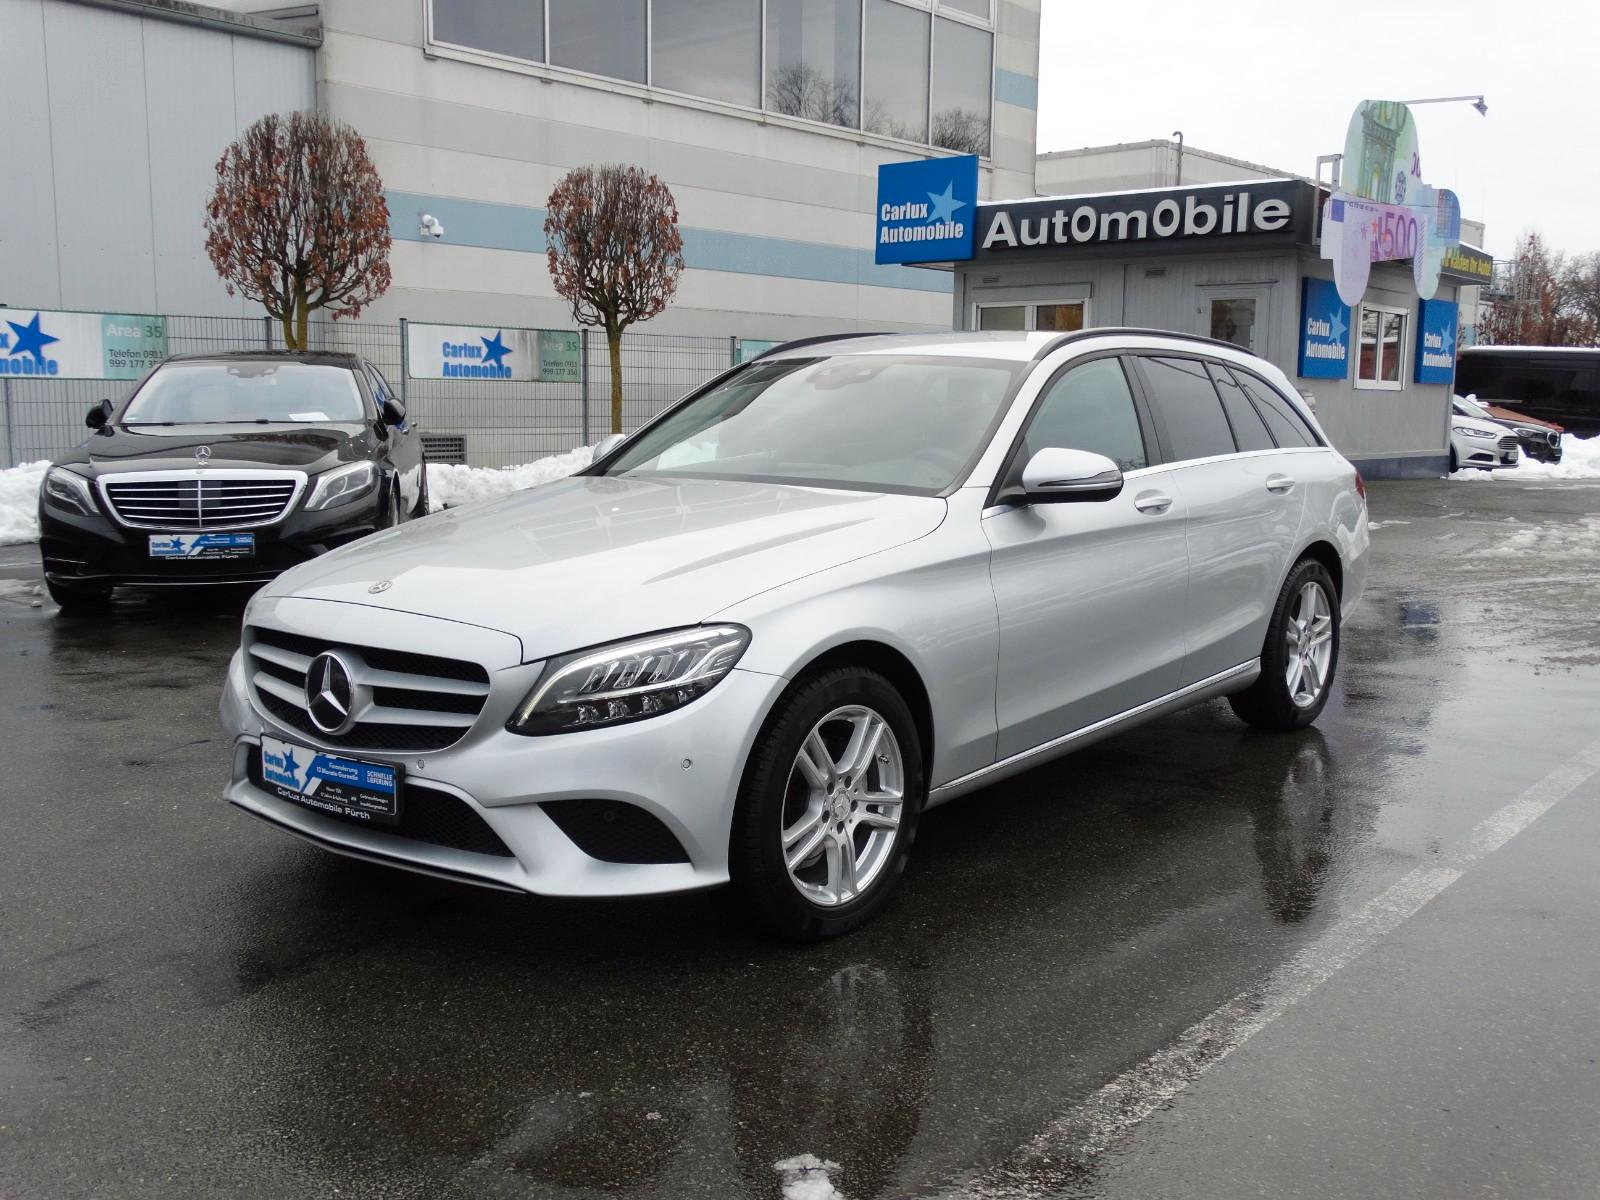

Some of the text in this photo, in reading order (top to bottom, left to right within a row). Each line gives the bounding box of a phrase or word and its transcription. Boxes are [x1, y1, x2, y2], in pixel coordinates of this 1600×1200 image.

[881, 201, 928, 221] Carlux
[880, 220, 964, 244] Automobile
[107, 323, 162, 338] Area 35
[1307, 317, 1331, 337] Carlux
[566, 341, 577, 351] 35
[1424, 332, 1442, 349] Carlux
[109, 348, 163, 359] Telefon 0911
[442, 341, 482, 359] Carlux
[1305, 339, 1345, 361] Automobile
[109, 359, 126, 368] 999
[129, 359, 144, 368] 177
[1422, 351, 1453, 369] Automobile
[442, 362, 512, 379] Automobile
[366, 776, 393, 787] LIEFERUNG
[367, 770, 393, 781] SCHNELLE
[301, 795, 343, 814] Automobile
[345, 807, 371, 820] Fürth
